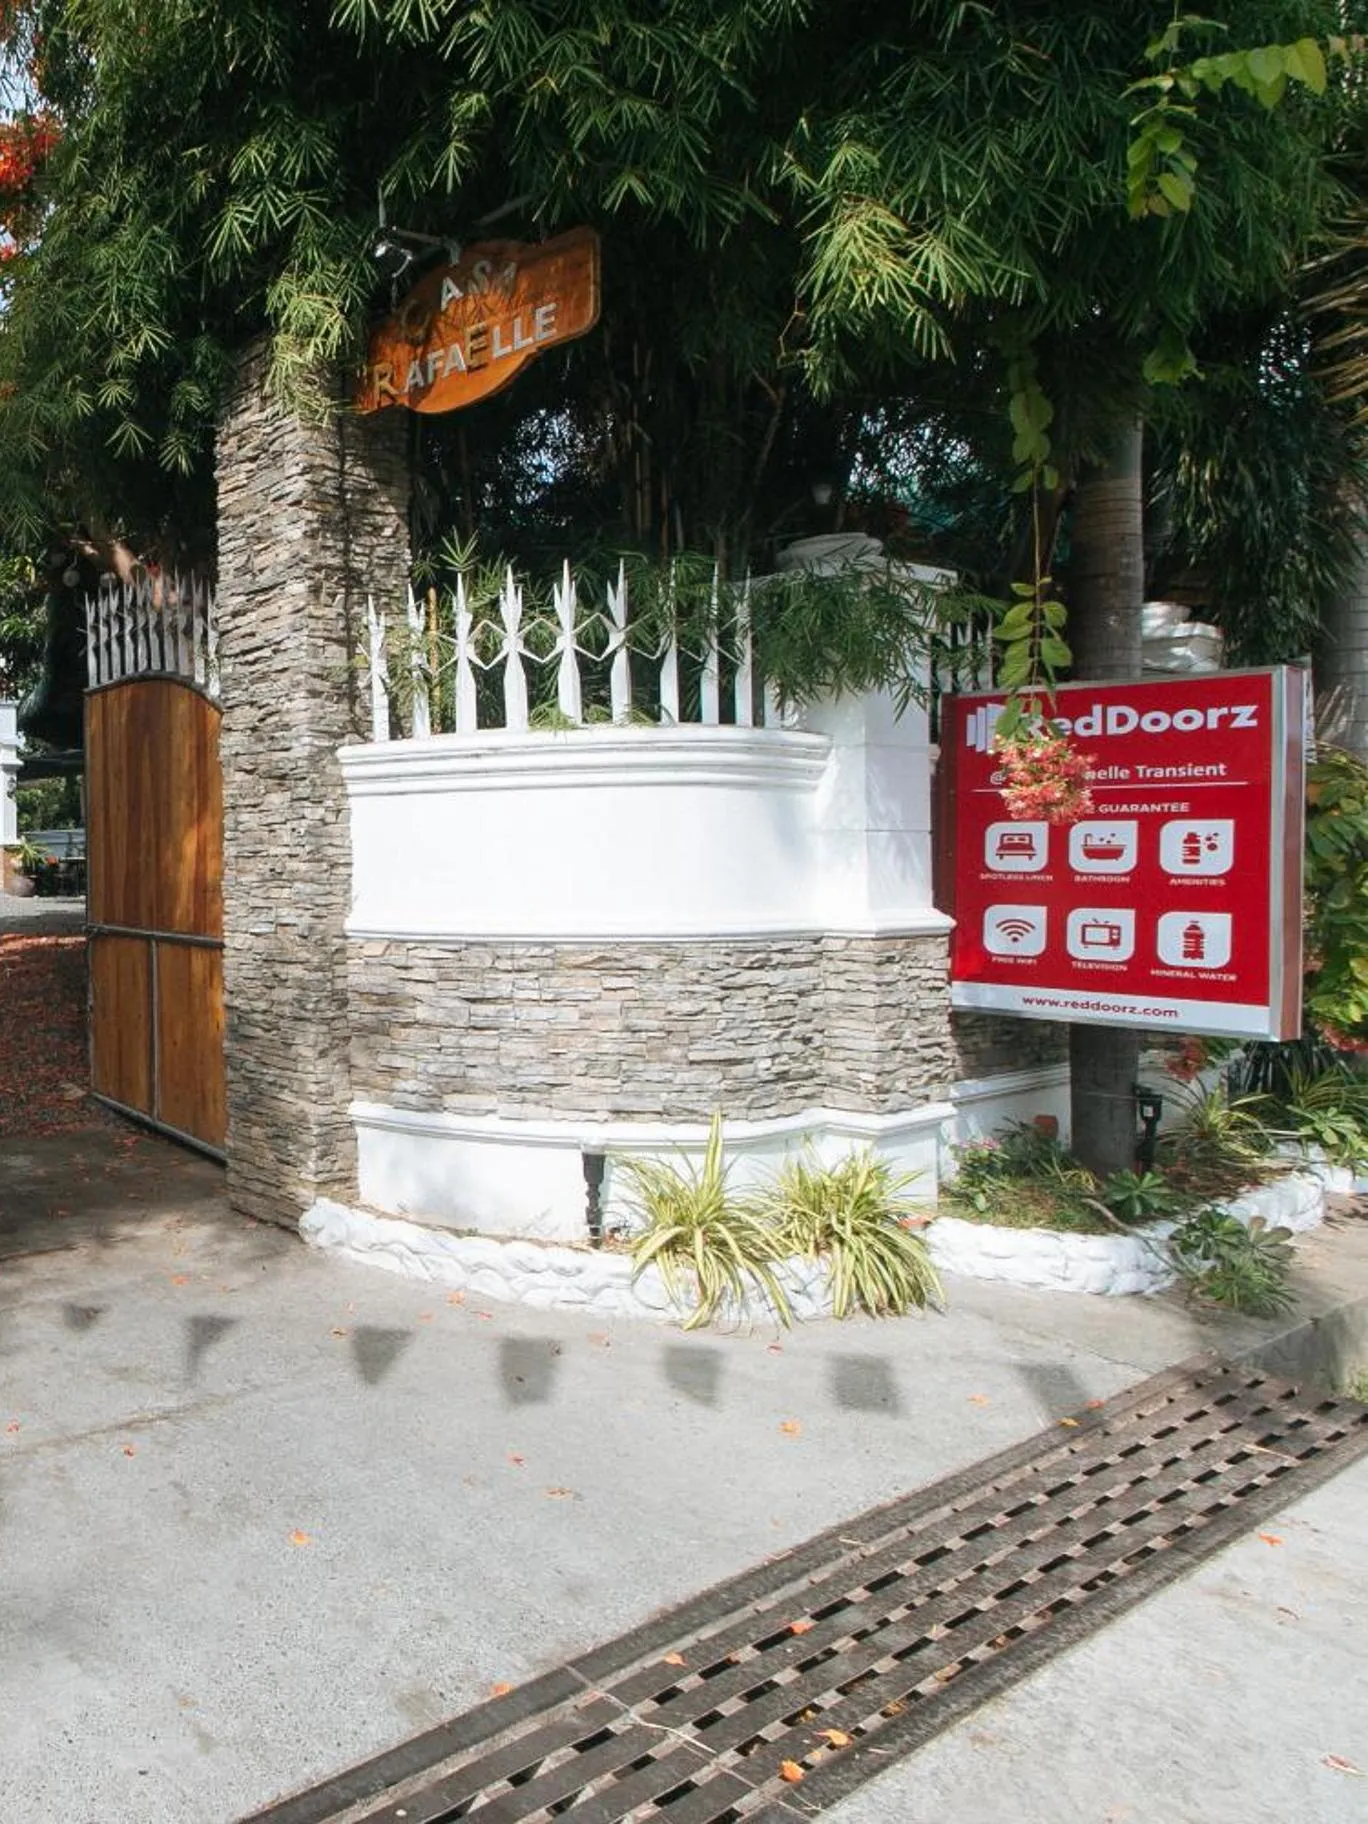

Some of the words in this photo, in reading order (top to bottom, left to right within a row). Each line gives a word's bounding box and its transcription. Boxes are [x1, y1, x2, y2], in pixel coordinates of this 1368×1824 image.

[373, 302, 558, 402] RAFAELLE
[1135, 762, 1228, 779] Transient
[1098, 802, 1190, 814] GUARANTEE
[1169, 878, 1227, 887] AMENITIES
[1071, 961, 1129, 972] TELEVISION
[1150, 969, 1196, 980] MINERAL
[1198, 971, 1238, 982] WATER
[1022, 996, 1179, 1019] www.reddoorz.com
